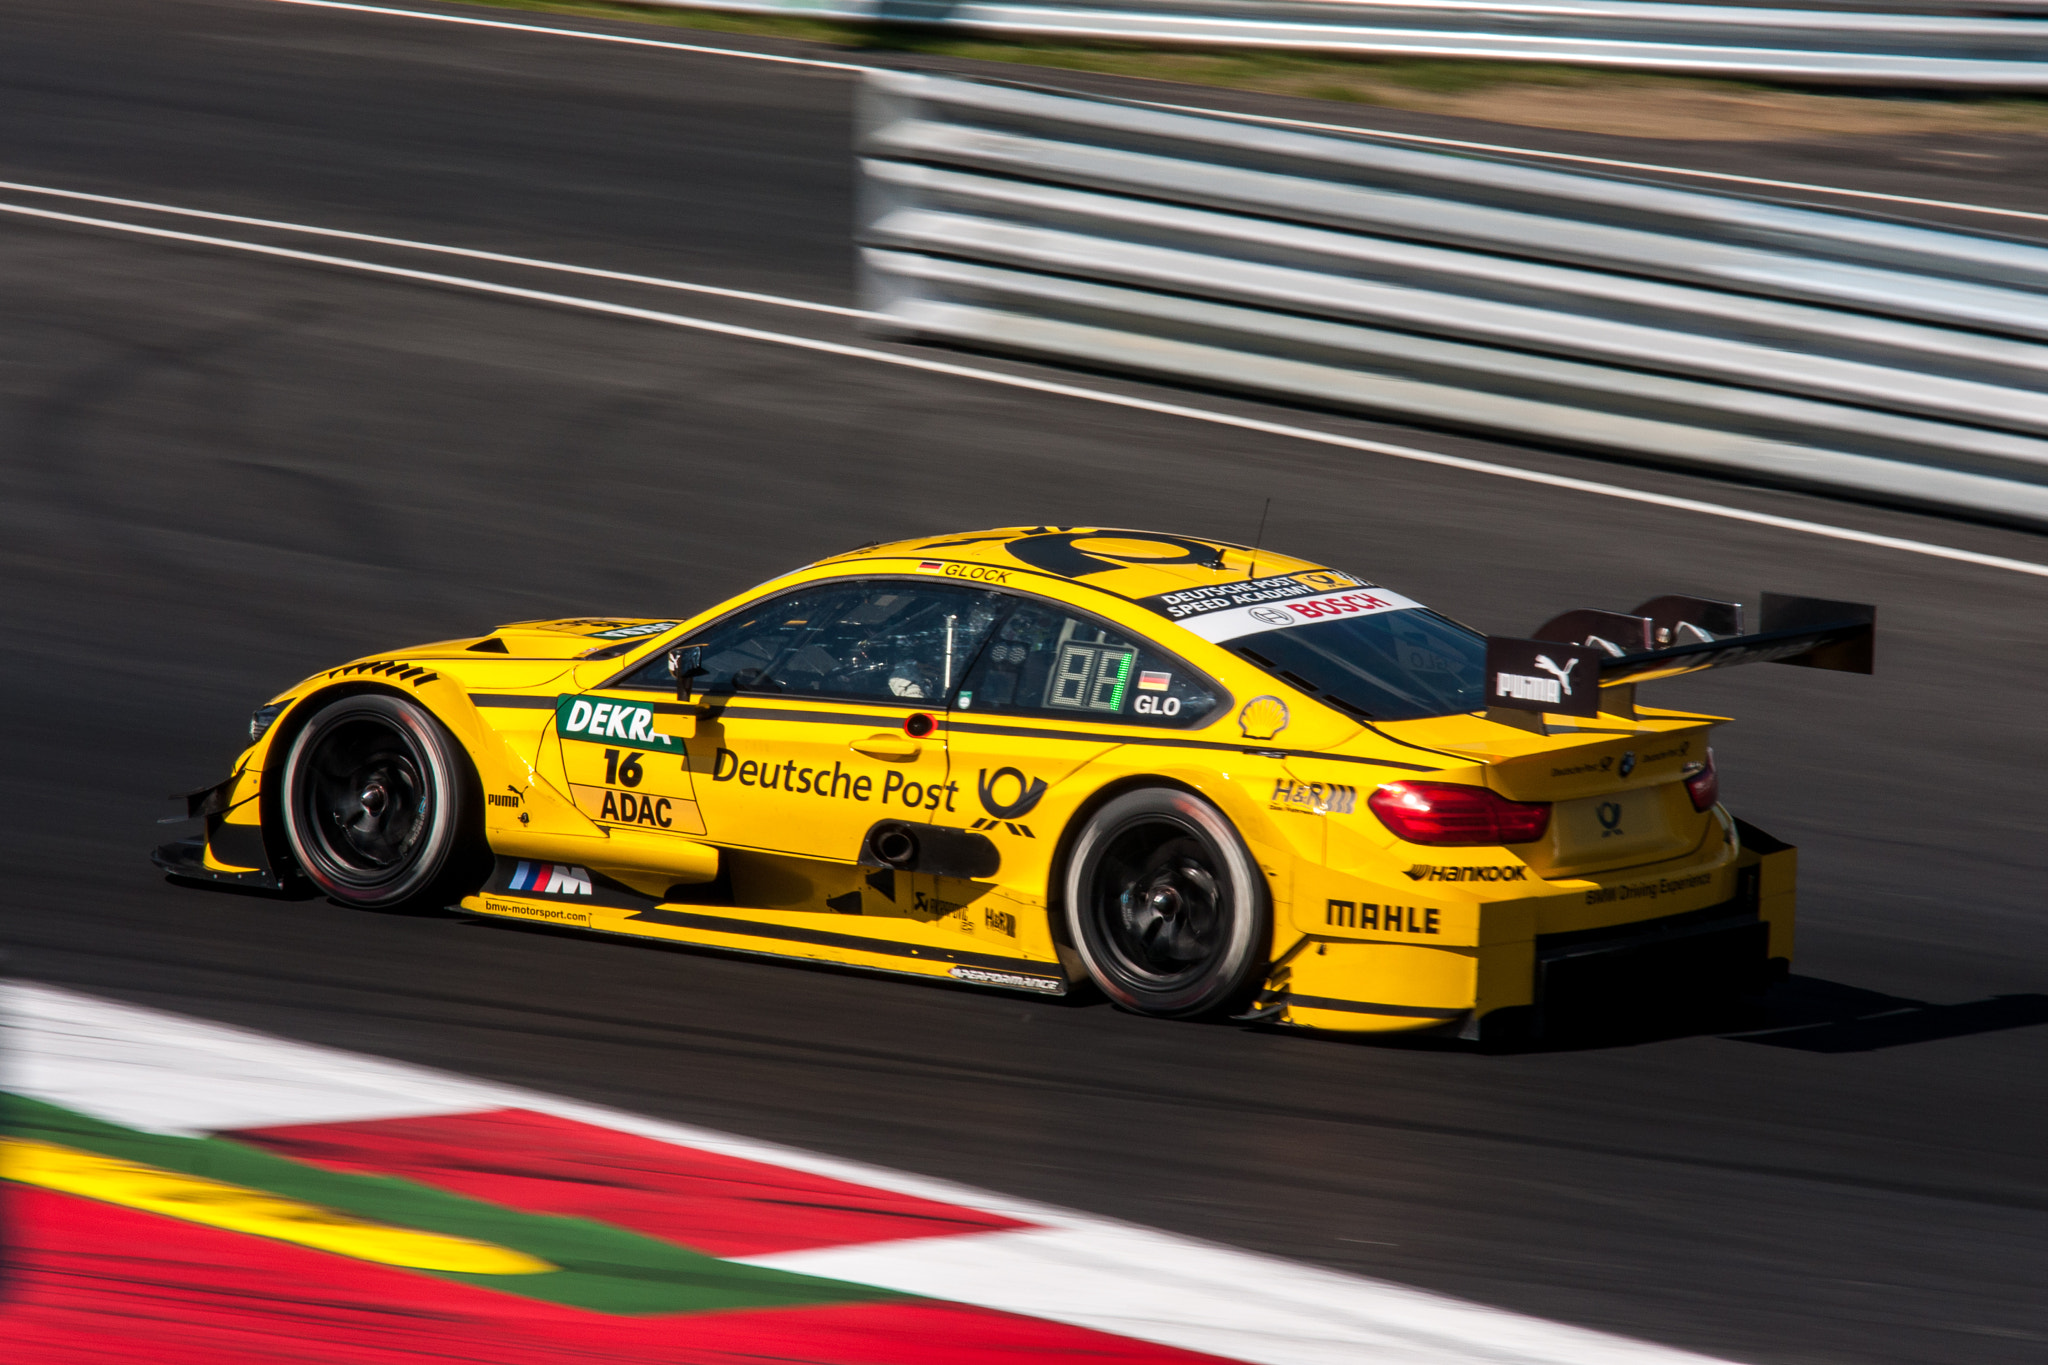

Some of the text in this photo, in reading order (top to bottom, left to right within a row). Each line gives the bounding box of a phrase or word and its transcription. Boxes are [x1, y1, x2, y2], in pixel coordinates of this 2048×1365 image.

[945, 564, 1013, 583] GLOCK
[1161, 576, 1298, 605] DEUTSCHE POST
[1167, 584, 1315, 618] SPEED ACADEMY
[1285, 592, 1393, 619] BOSCH
[1133, 694, 1181, 716] GLO
[604, 748, 645, 788] 16
[712, 747, 959, 813] Deutsche Post
[488, 793, 519, 809] PUMA
[600, 790, 673, 828] ADAC
[485, 900, 587, 922] bmw-motorsport.com
[1326, 898, 1441, 935] MAHLE
